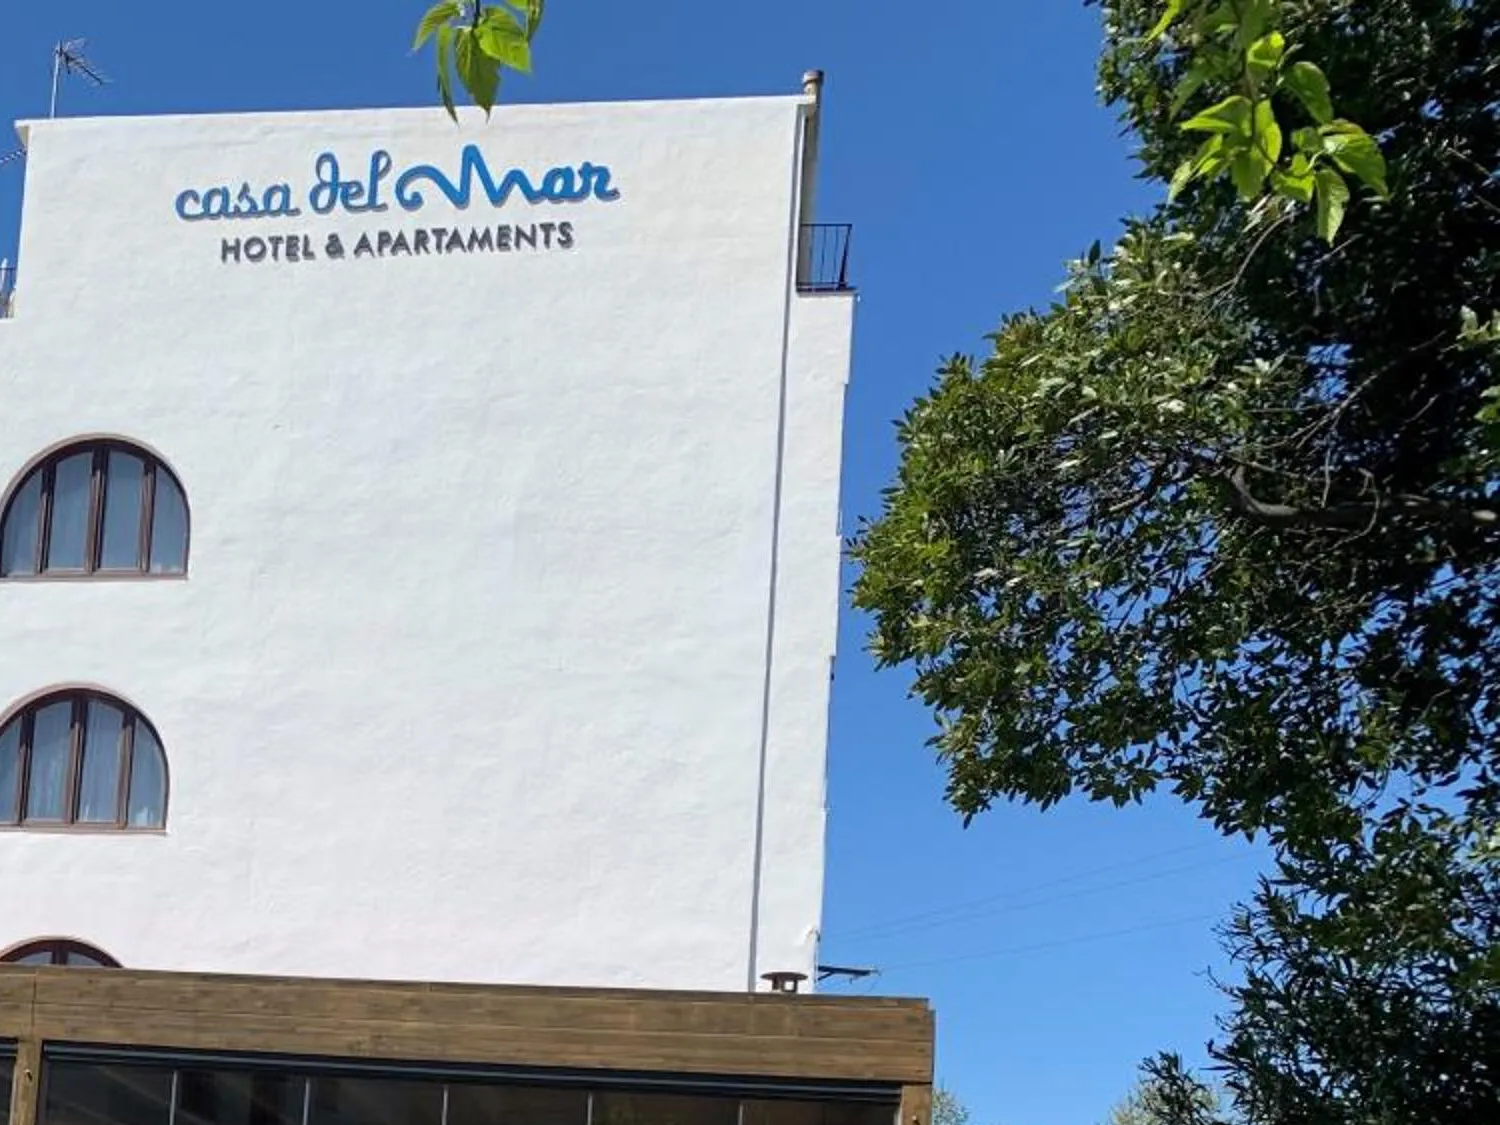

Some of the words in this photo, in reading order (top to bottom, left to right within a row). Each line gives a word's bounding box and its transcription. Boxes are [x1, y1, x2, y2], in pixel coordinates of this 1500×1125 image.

[175, 181, 302, 222] casa
[308, 149, 393, 215] del
[394, 143, 621, 211] Mar
[221, 233, 317, 264] HOTEL
[324, 231, 346, 260] &
[352, 220, 575, 259] APARTAMENTS
